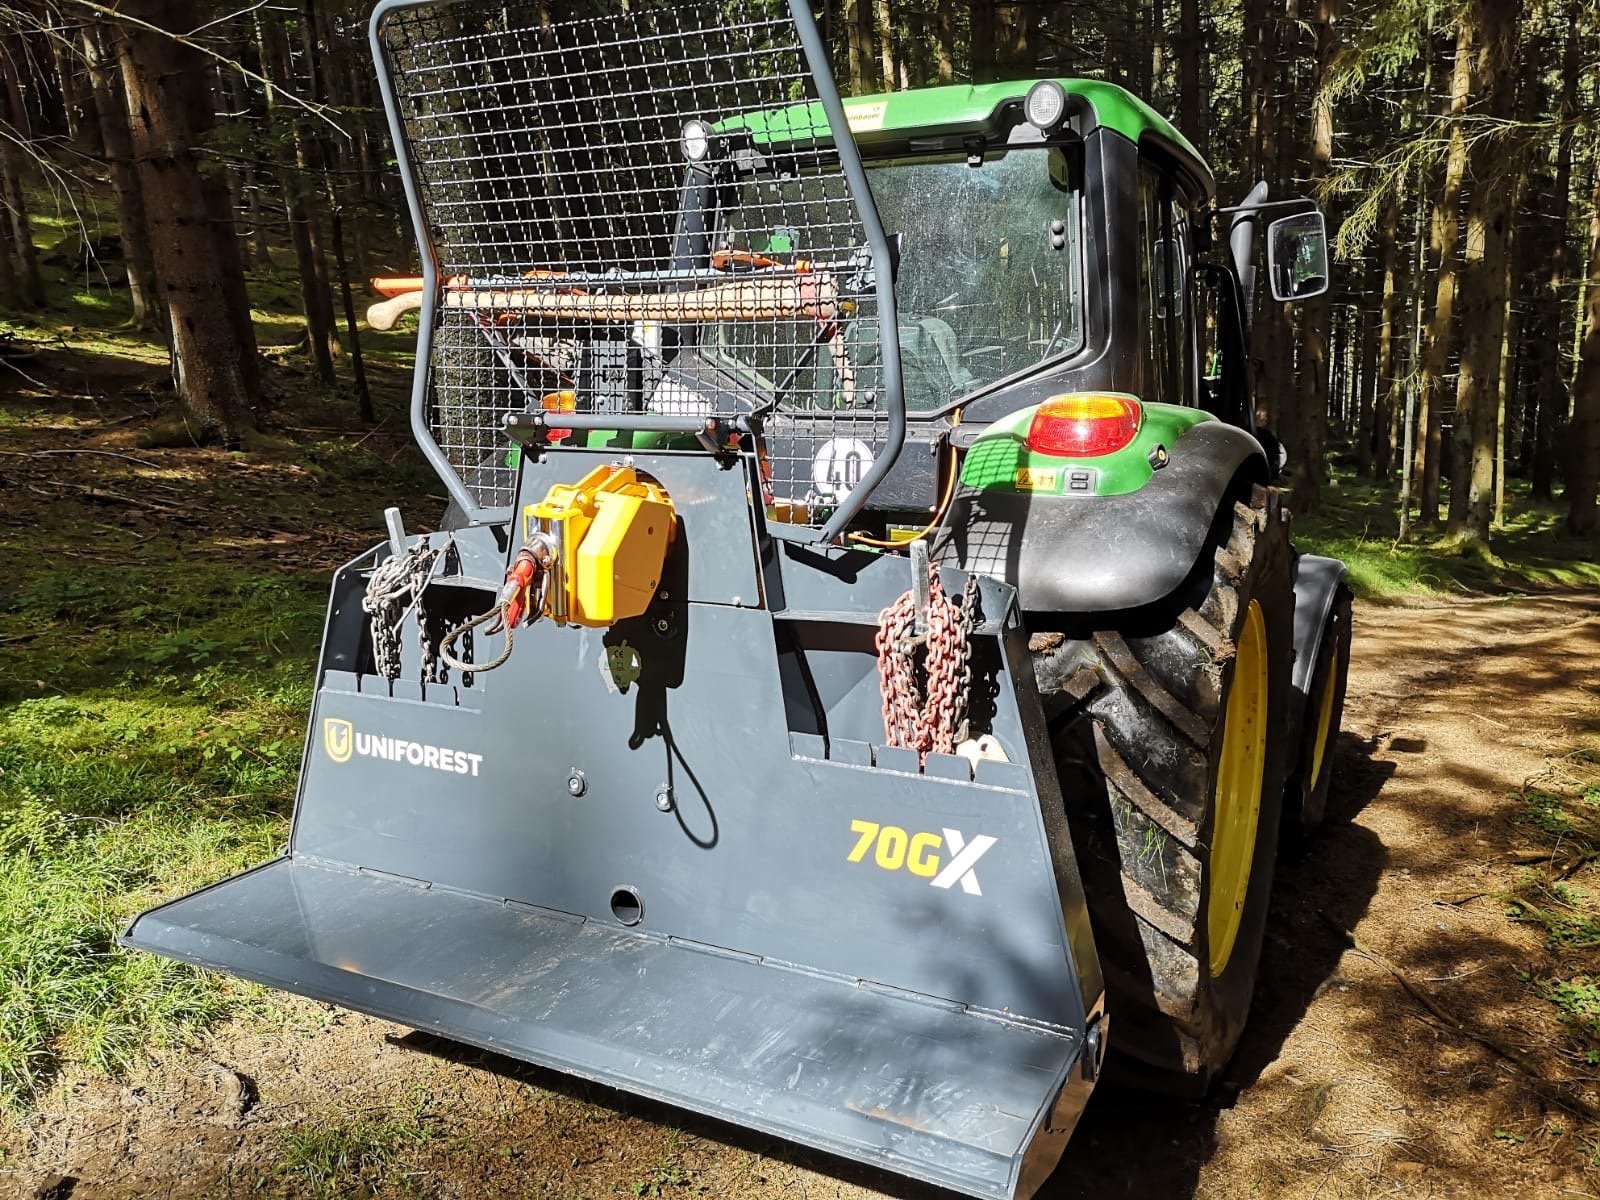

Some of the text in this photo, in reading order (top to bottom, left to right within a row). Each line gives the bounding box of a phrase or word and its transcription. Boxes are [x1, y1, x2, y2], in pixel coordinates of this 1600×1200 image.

[826, 450, 861, 491] 40
[355, 732, 483, 776] UNIFOREST
[847, 819, 999, 896] 70GX
